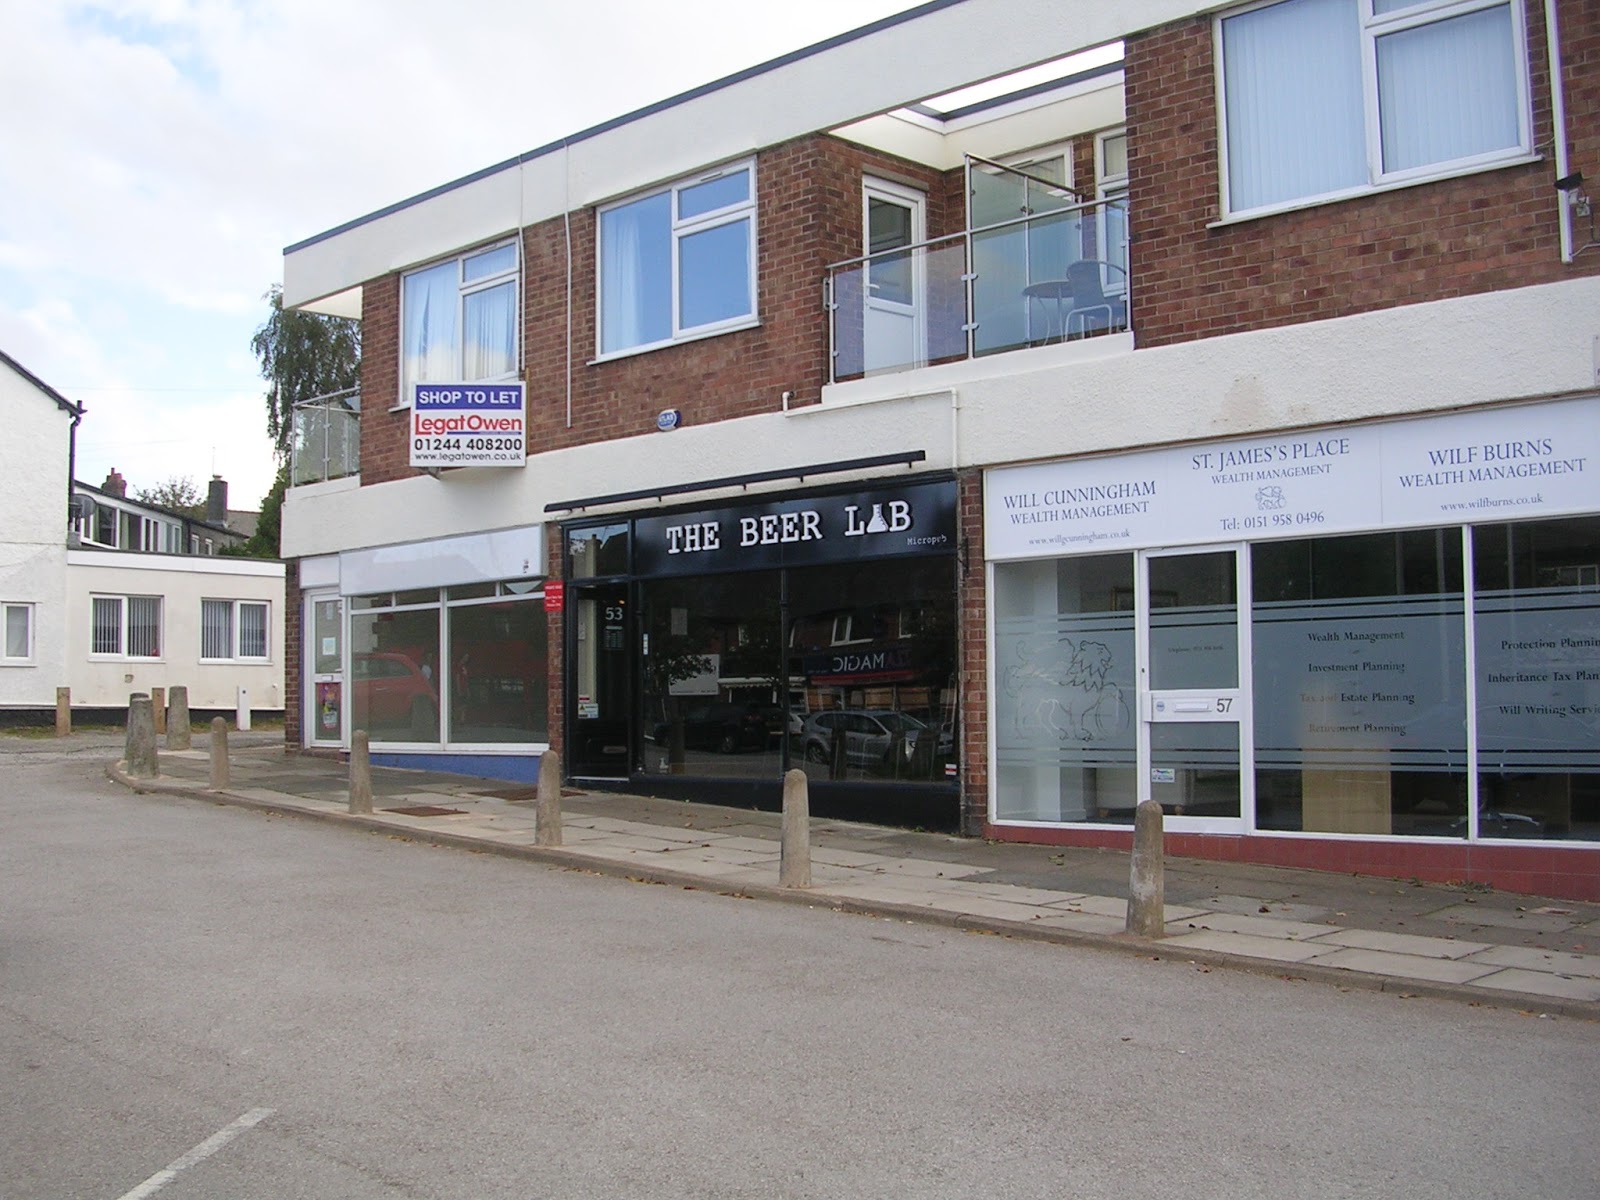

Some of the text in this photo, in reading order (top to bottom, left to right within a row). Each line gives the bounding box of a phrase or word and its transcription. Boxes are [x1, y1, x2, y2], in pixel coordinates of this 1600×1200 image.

[419, 391, 519, 404] SHOP TO LET
[414, 438, 522, 450] 01244 408200
[414, 452, 522, 462] www.legatowen.co.uk
[1192, 453, 1214, 470] ST.
[1292, 438, 1350, 460] PLACE
[1428, 438, 1553, 466] WILF BURNS
[1211, 463, 1332, 484] WEALTH MANAGEMENT
[1399, 458, 1587, 488] WEALTH MANAGEMENT
[1003, 480, 1157, 509] WILL CUNNINGHAM
[1010, 500, 1150, 525] WEALTH MANAGEMENT
[1220, 510, 1325, 531] Tel: 0151 958 0496
[666, 521, 719, 554] THE
[740, 510, 823, 547] BEER
[605, 606, 623, 620] 53
[1308, 631, 1405, 644] Wealth Management
[1501, 639, 1556, 650] Protection
[1308, 661, 1405, 674] Investment Planning
[1488, 670, 1600, 683] Inheritance Tax Plan
[1216, 698, 1233, 713] 57
[1341, 692, 1369, 702] Estate
[1372, 692, 1415, 705] Plannng
[1499, 705, 1521, 715] Will
[1525, 704, 1567, 718] Writing
[1363, 723, 1407, 737] Planning
